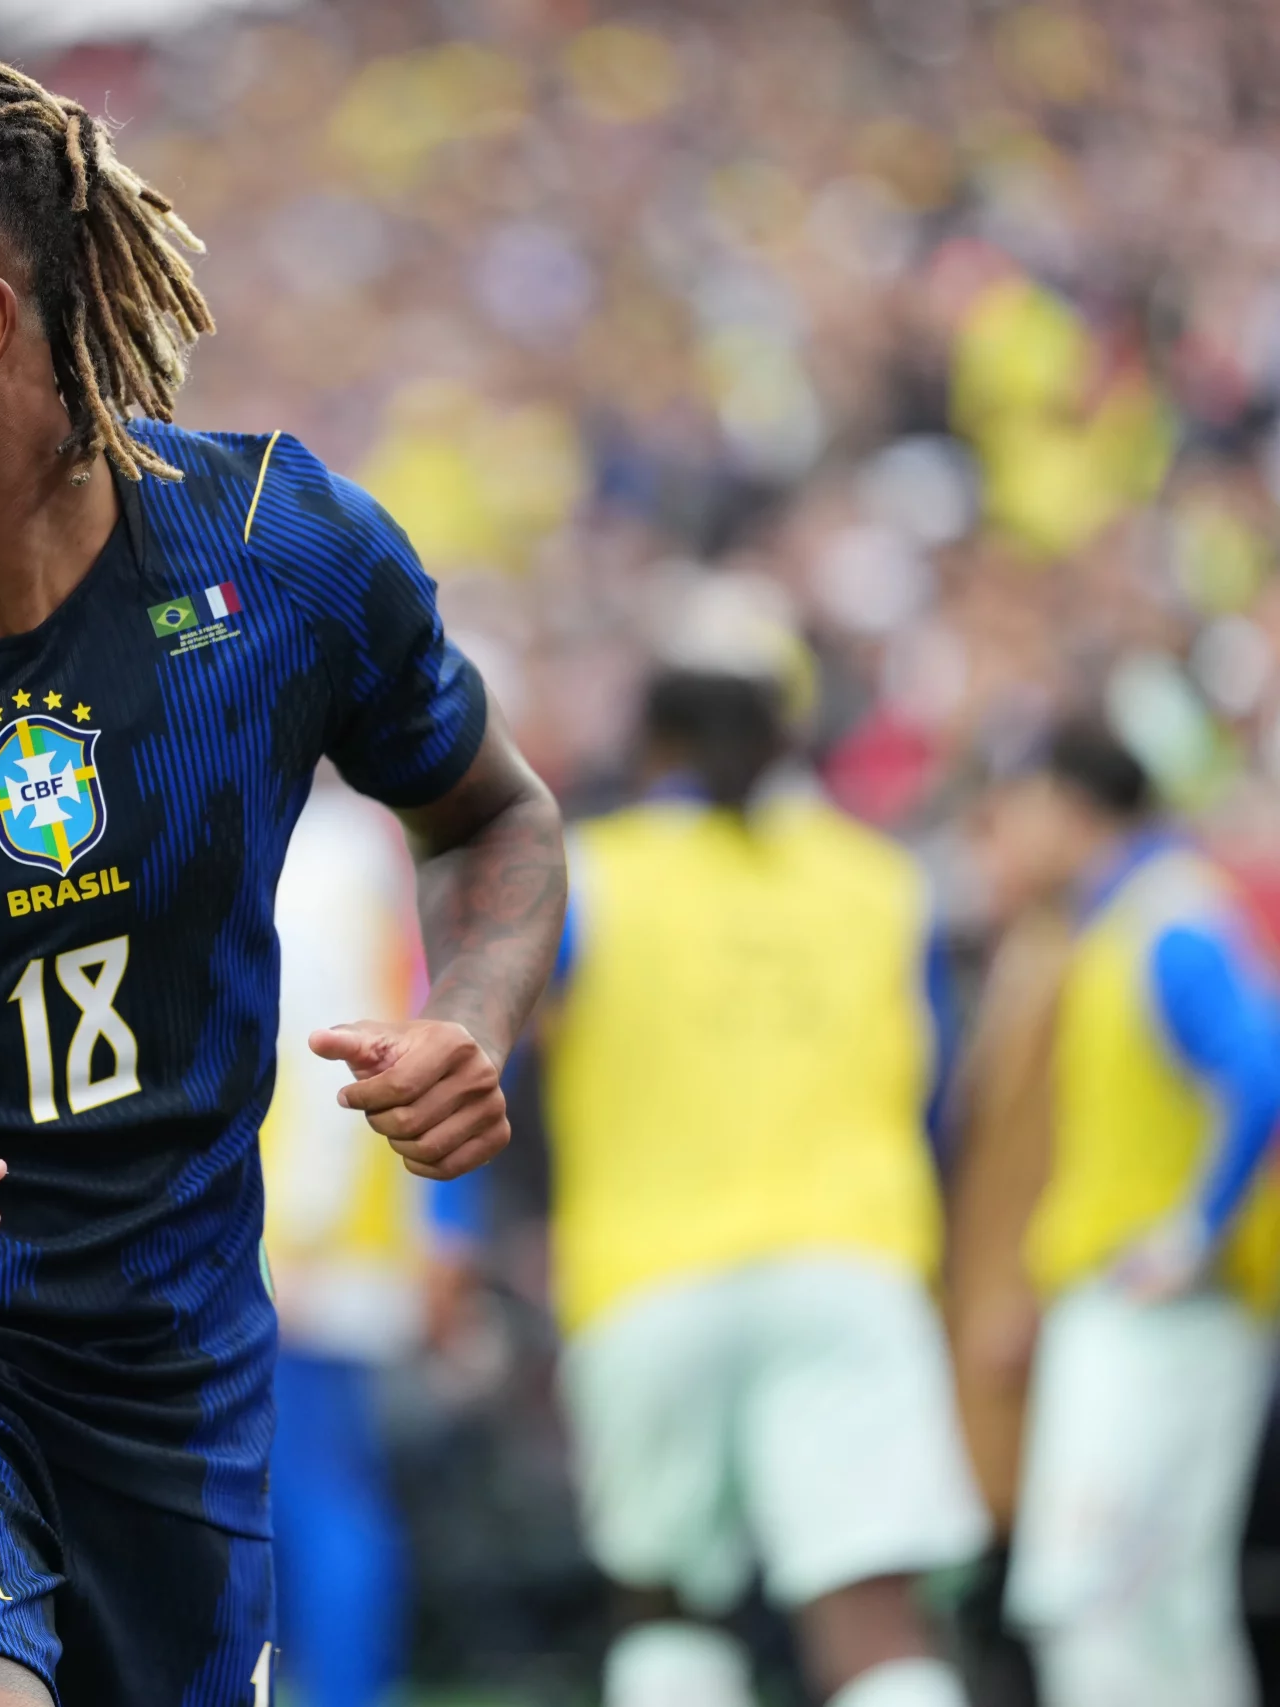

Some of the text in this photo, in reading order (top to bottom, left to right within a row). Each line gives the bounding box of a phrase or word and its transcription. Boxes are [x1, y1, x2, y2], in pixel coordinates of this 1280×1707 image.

[20, 776, 63, 802] CBF
[6, 866, 130, 918] BRASIL
[7, 934, 142, 1124] 18
